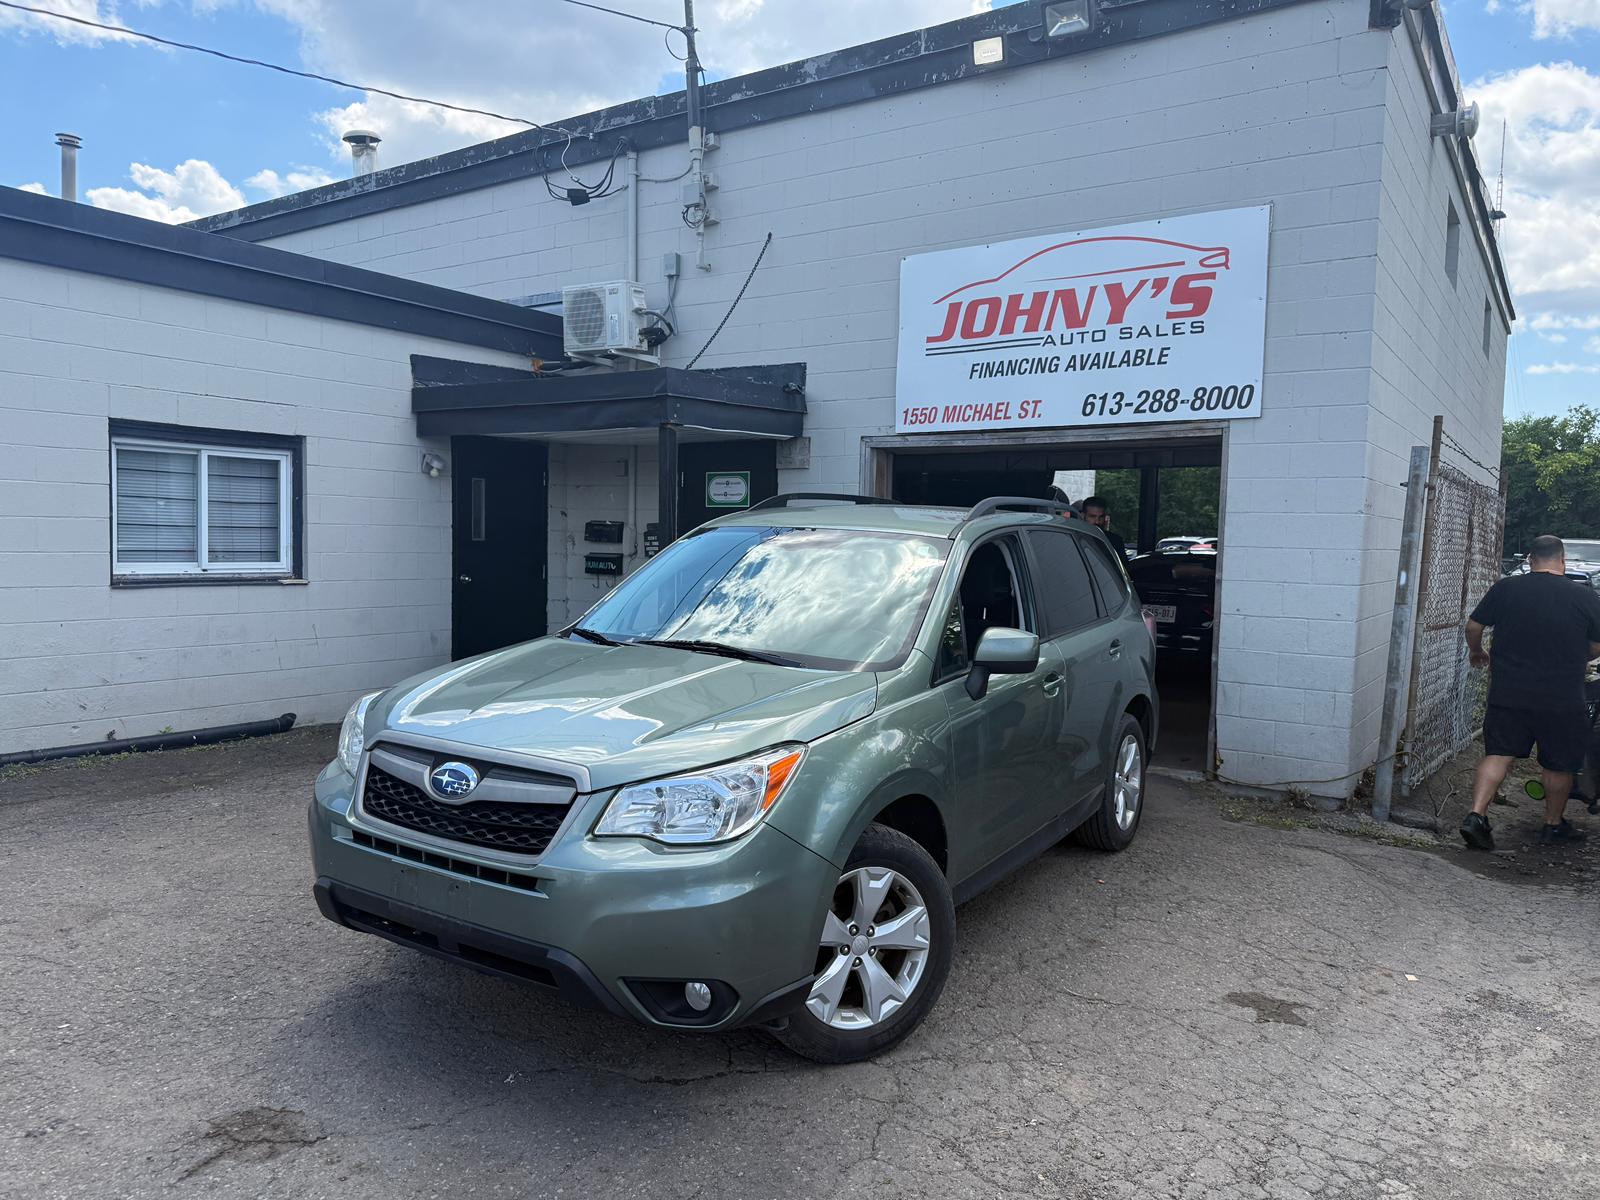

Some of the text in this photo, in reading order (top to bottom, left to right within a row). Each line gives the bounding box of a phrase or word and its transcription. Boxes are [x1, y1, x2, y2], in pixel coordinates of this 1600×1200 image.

[926, 271, 1217, 343] JOHNY'S
[1042, 321, 1205, 347] AUTO SALES
[969, 346, 1171, 380] FINANCING AVAILABLE
[902, 400, 1043, 426] 1550 MICHAEL ST.
[1081, 384, 1255, 417] 613-288-8000
